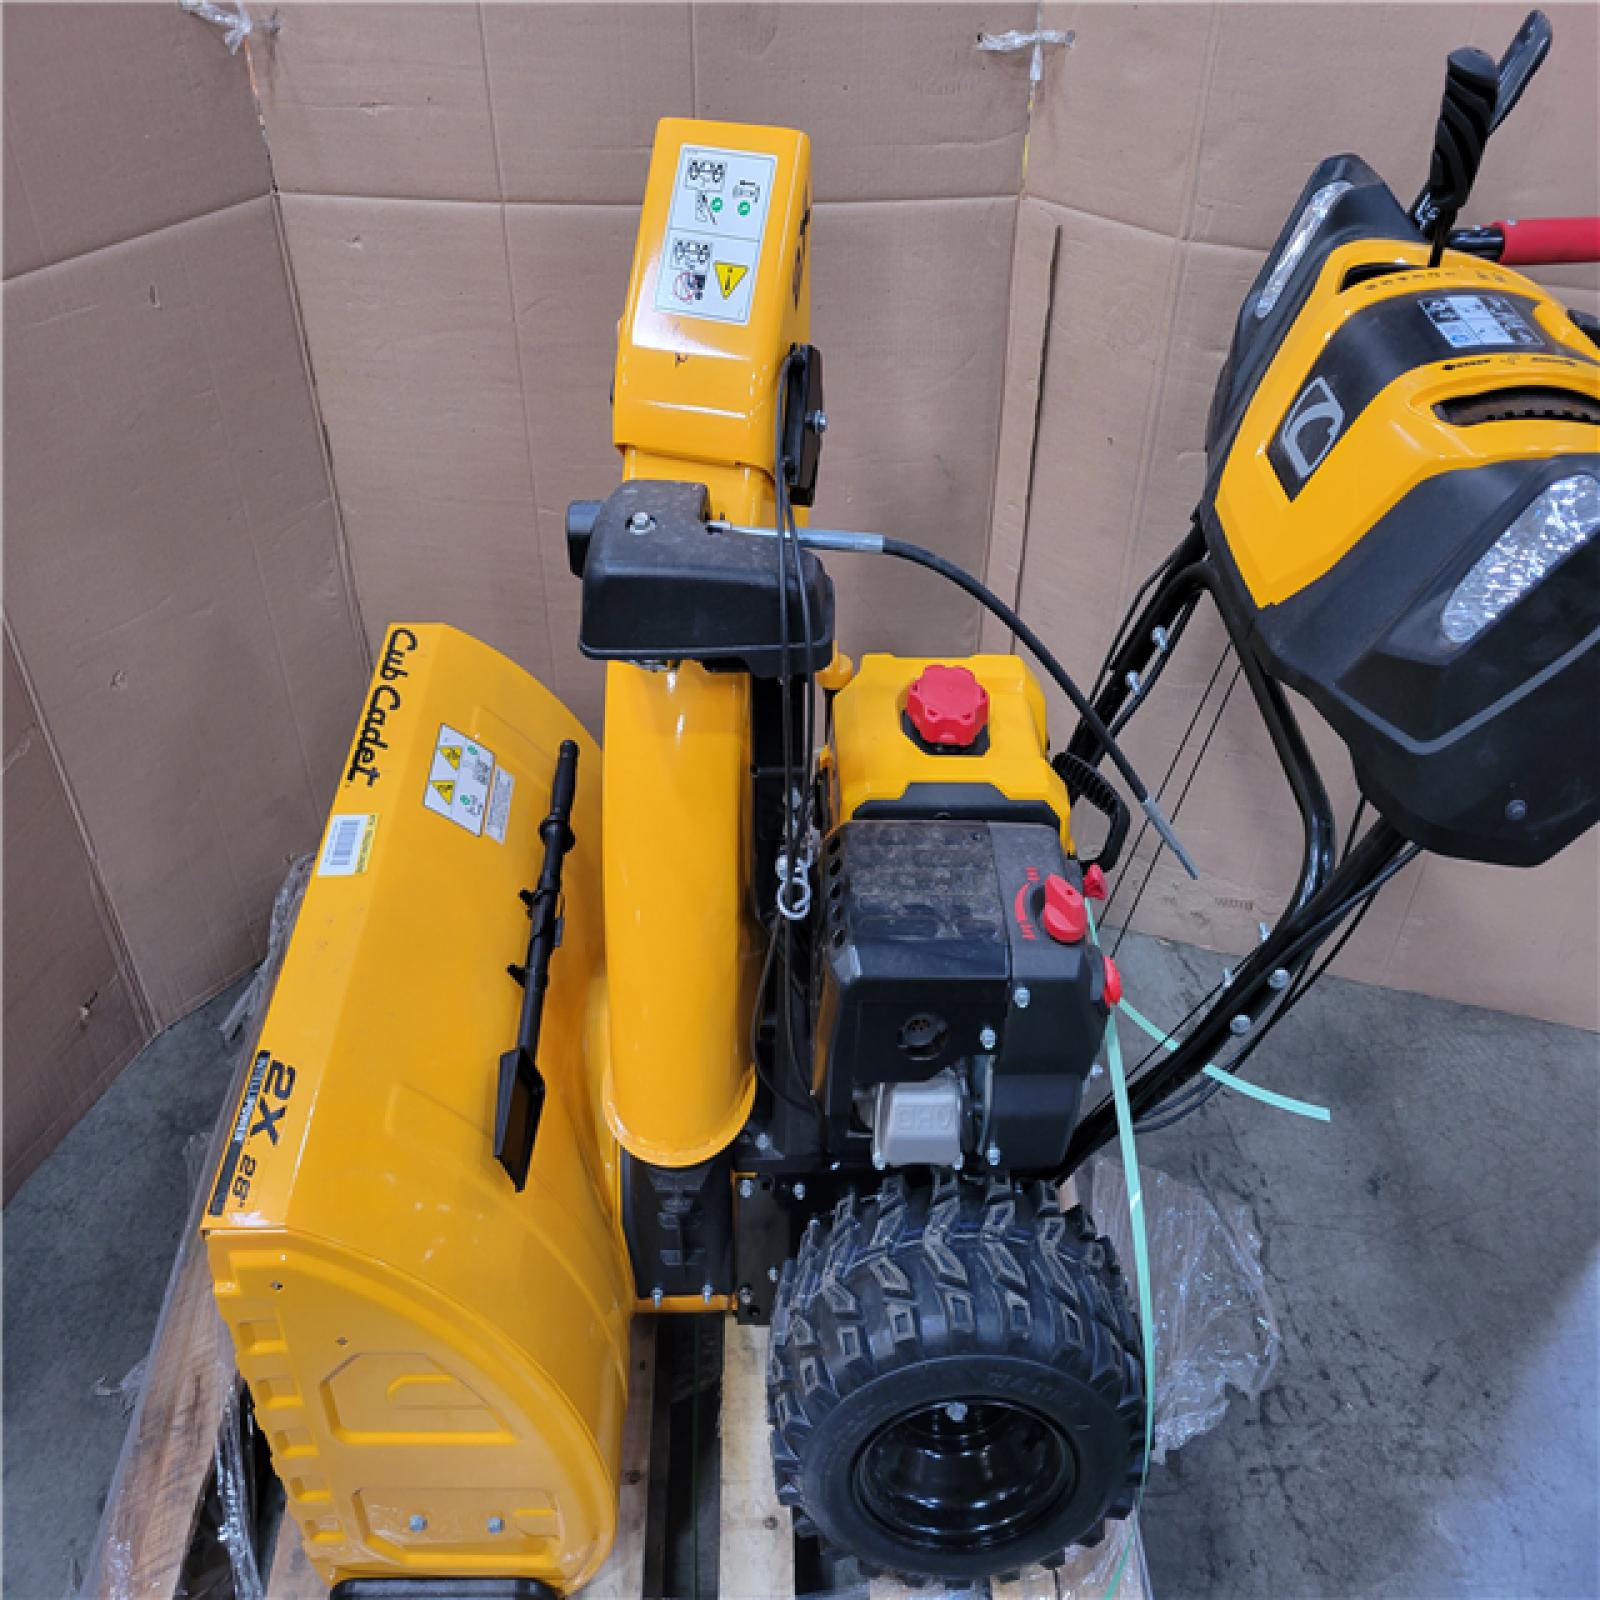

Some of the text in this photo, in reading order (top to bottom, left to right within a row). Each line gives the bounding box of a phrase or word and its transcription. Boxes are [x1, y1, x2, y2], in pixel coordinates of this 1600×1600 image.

[380, 627, 418, 681] Cub
[347, 684, 401, 788] Cadet
[250, 1059, 296, 1146] 2X
